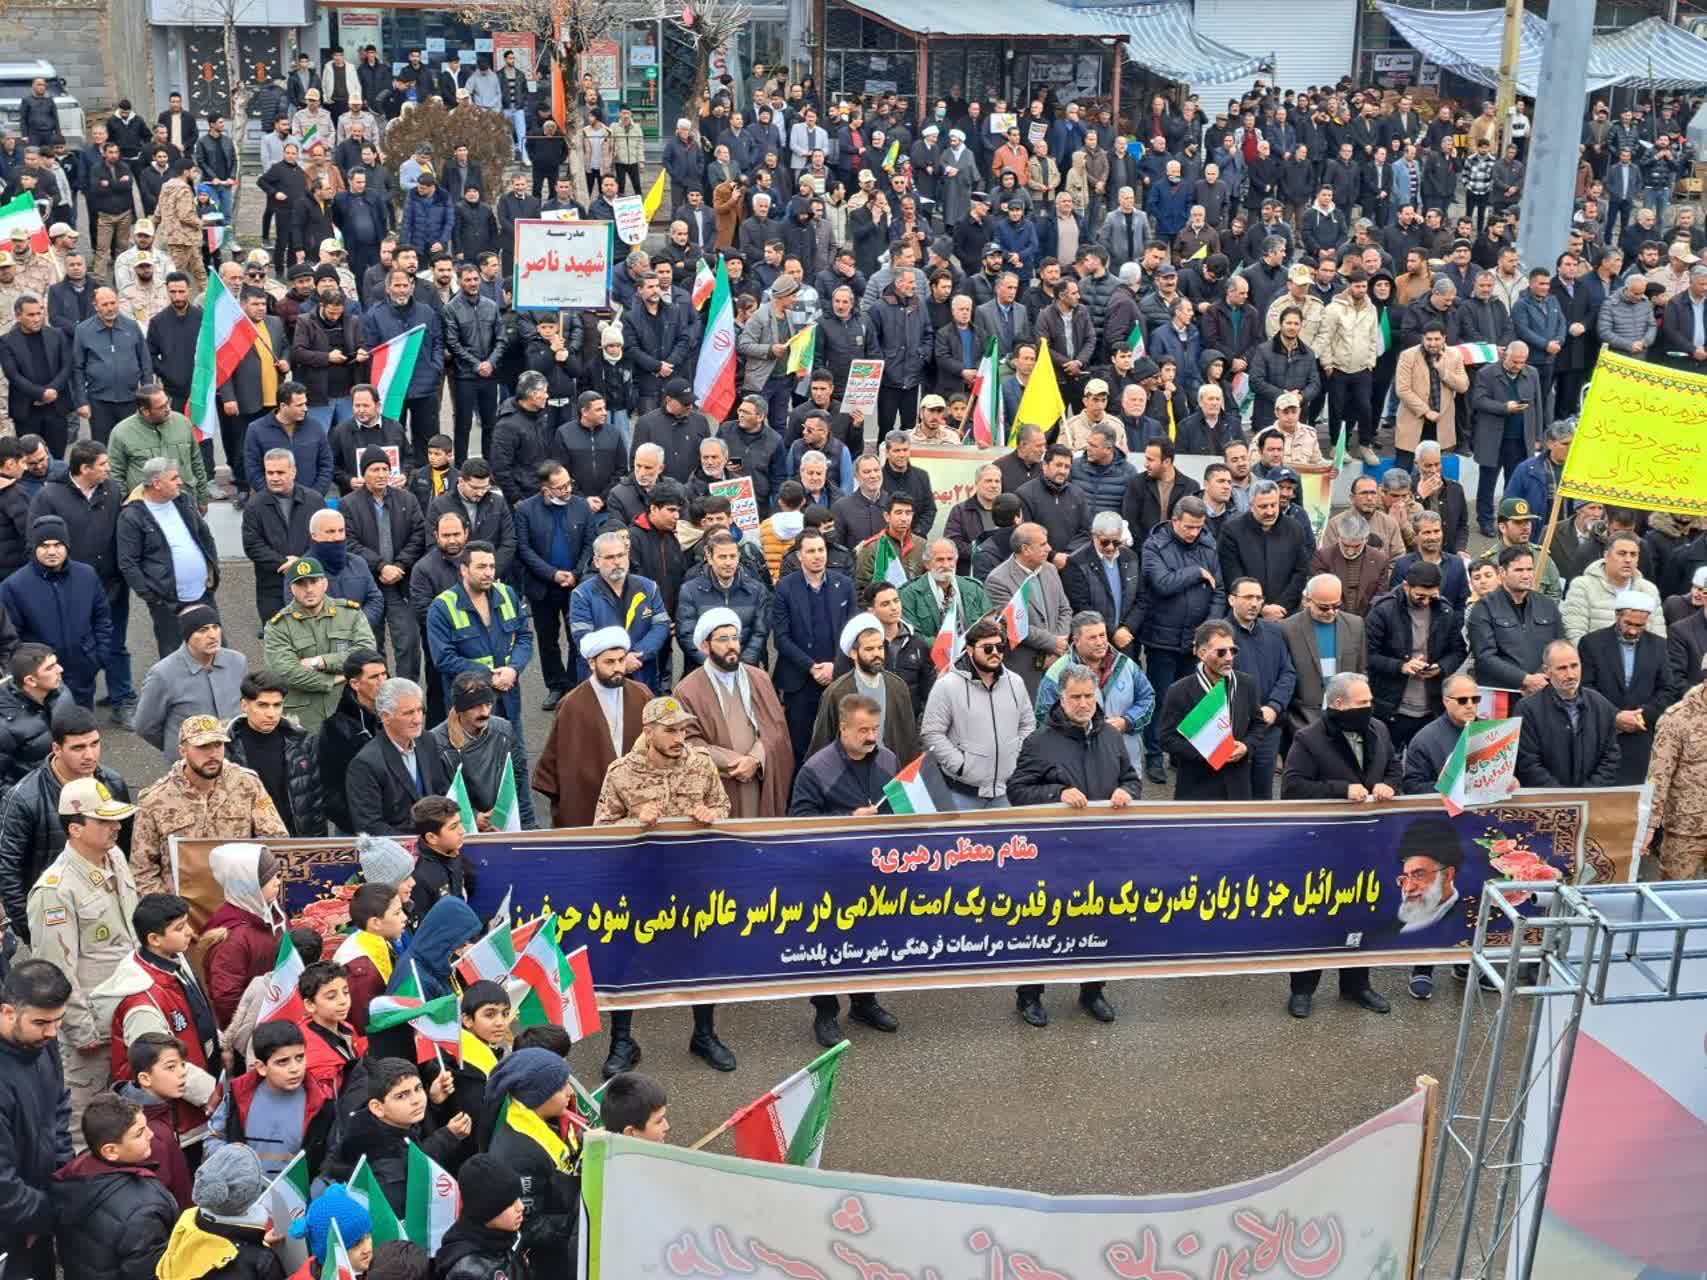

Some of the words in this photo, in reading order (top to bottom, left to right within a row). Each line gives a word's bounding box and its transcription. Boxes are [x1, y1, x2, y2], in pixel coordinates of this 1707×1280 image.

[546, 228, 585, 240] مدرسه
[521, 249, 559, 279] ناصر
[565, 246, 606, 278] شهید
[872, 845, 941, 873] رهبری:
[944, 836, 995, 870] معظم
[997, 834, 1039, 867] مقام
[837, 885, 908, 929] اسلامی
[910, 886, 952, 916] امت
[954, 885, 986, 923] یک
[991, 880, 1047, 925] قدرت
[1067, 880, 1104, 917] ملت
[1109, 880, 1140, 922] یک
[1144, 875, 1198, 923] قدرت
[1200, 875, 1241, 920] زبان
[1246, 874, 1259, 917] با
[1261, 880, 1290, 918] جز
[1293, 867, 1364, 916] اسرائیل
[1366, 869, 1381, 912] با
[588, 895, 630, 944] شود
[634, 894, 677, 944] نمی
[740, 887, 803, 937] سراسر
[806, 891, 832, 933] در
[1048, 897, 1062, 926] و
[780, 943, 827, 967] پلدشت
[830, 939, 889, 965] شهرستان
[891, 935, 944, 962] فرهنگی
[946, 934, 1004, 956] مراسمات
[1007, 934, 1076, 954] بزرگداشت
[1079, 933, 1108, 948] ستاد
